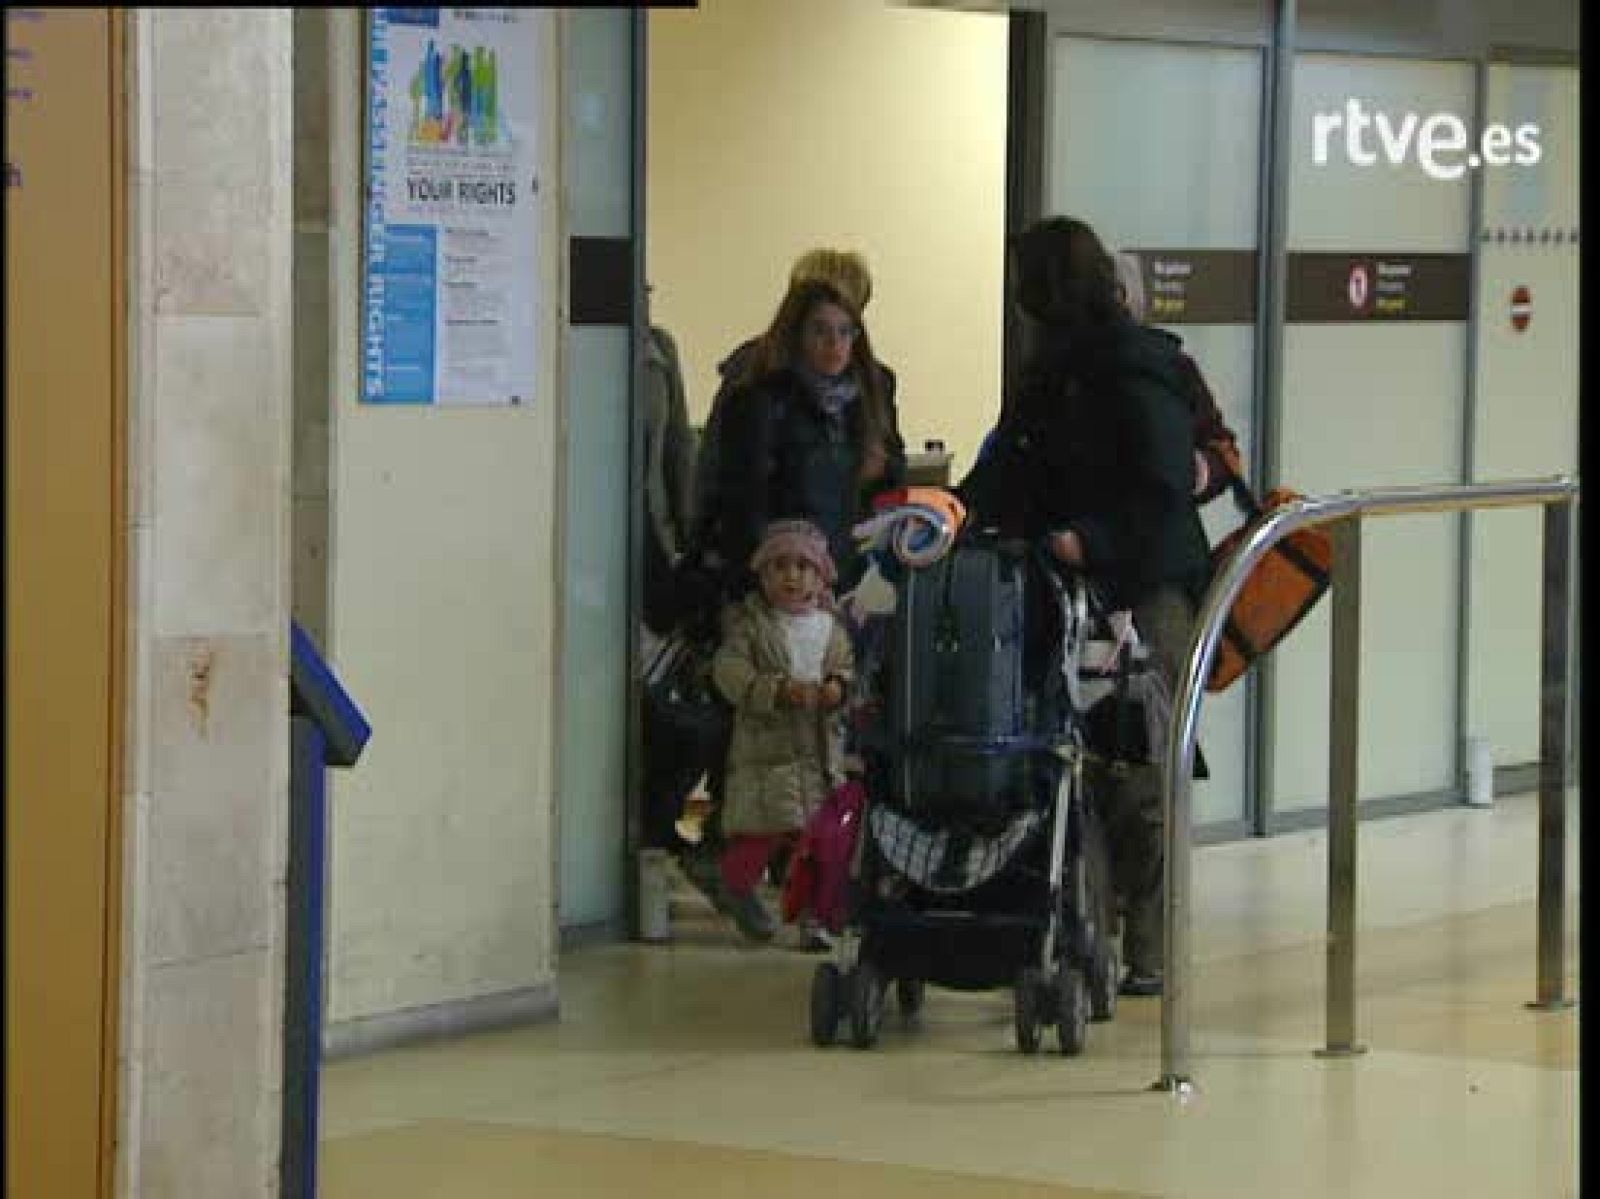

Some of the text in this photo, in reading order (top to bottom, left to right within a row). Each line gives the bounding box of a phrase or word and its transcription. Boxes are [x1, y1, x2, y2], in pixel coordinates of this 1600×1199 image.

[406, 177, 516, 206] YOUR RIGHTS
[367, 273, 385, 396] RIGHTS
